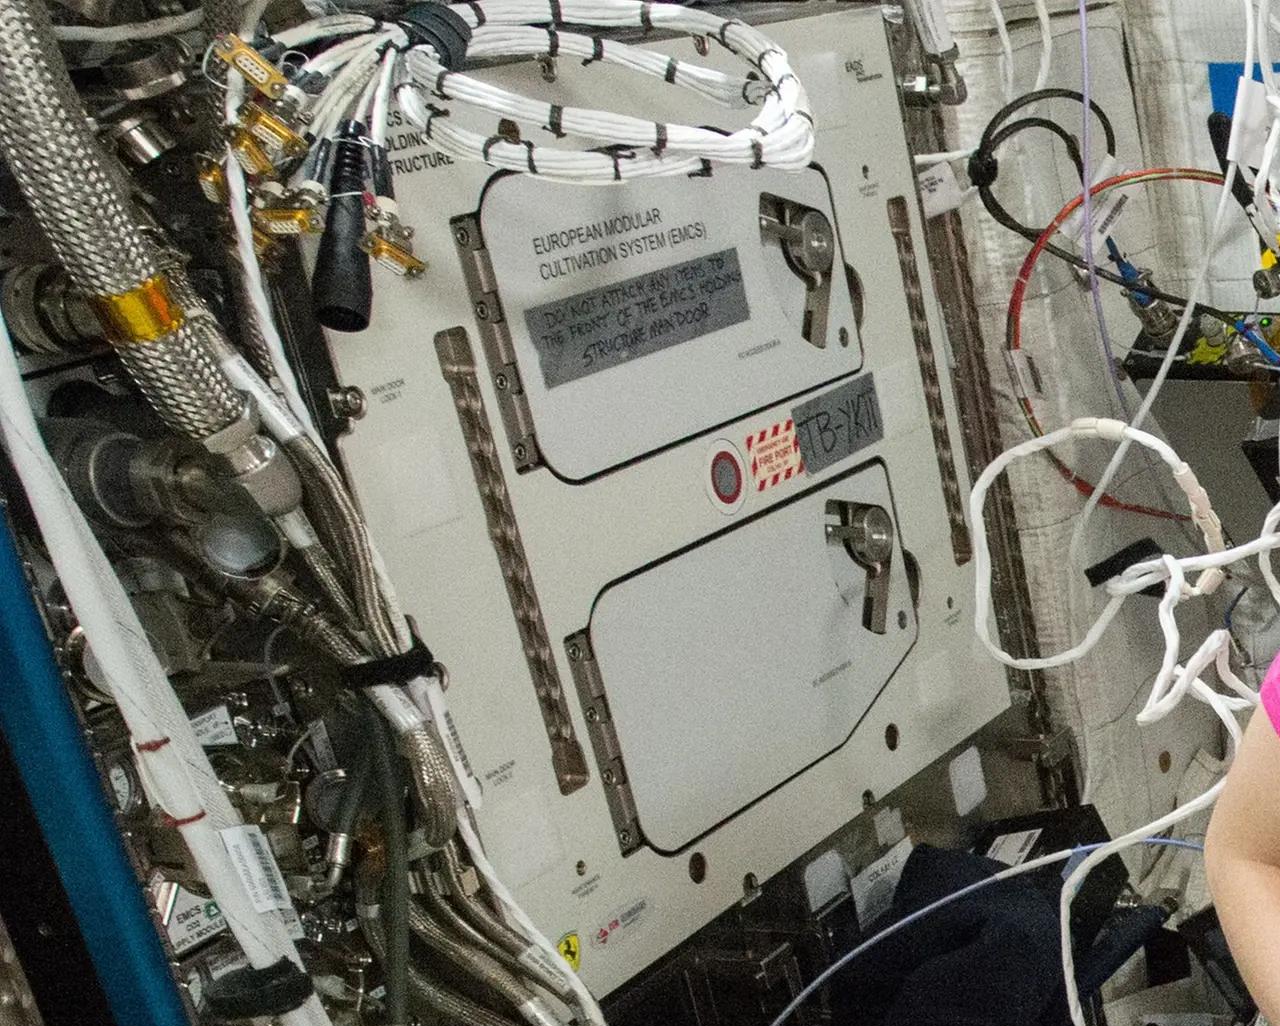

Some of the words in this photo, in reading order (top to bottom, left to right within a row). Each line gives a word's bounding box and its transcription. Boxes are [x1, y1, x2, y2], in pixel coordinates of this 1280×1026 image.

[387, 152, 454, 176] TRUCTURE
[532, 222, 604, 255] EUROPEAN
[604, 207, 662, 238] MODULAR
[540, 246, 618, 281] CULTIVATION
[619, 232, 666, 259] SYSTEM
[669, 221, 707, 248] (EMCS)
[570, 298, 599, 320] NOT
[602, 281, 645, 308] ATTACK
[649, 273, 670, 294] ANY
[708, 256, 725, 272] TO
[570, 312, 610, 338] FRONT
[635, 296, 658, 316] THE
[582, 326, 647, 368] STRUCTURE
[673, 301, 711, 328] DOOR
[758, 452, 774, 468] FIRE
[774, 445, 792, 460] PORT
[176, 905, 202, 924] EMCS
